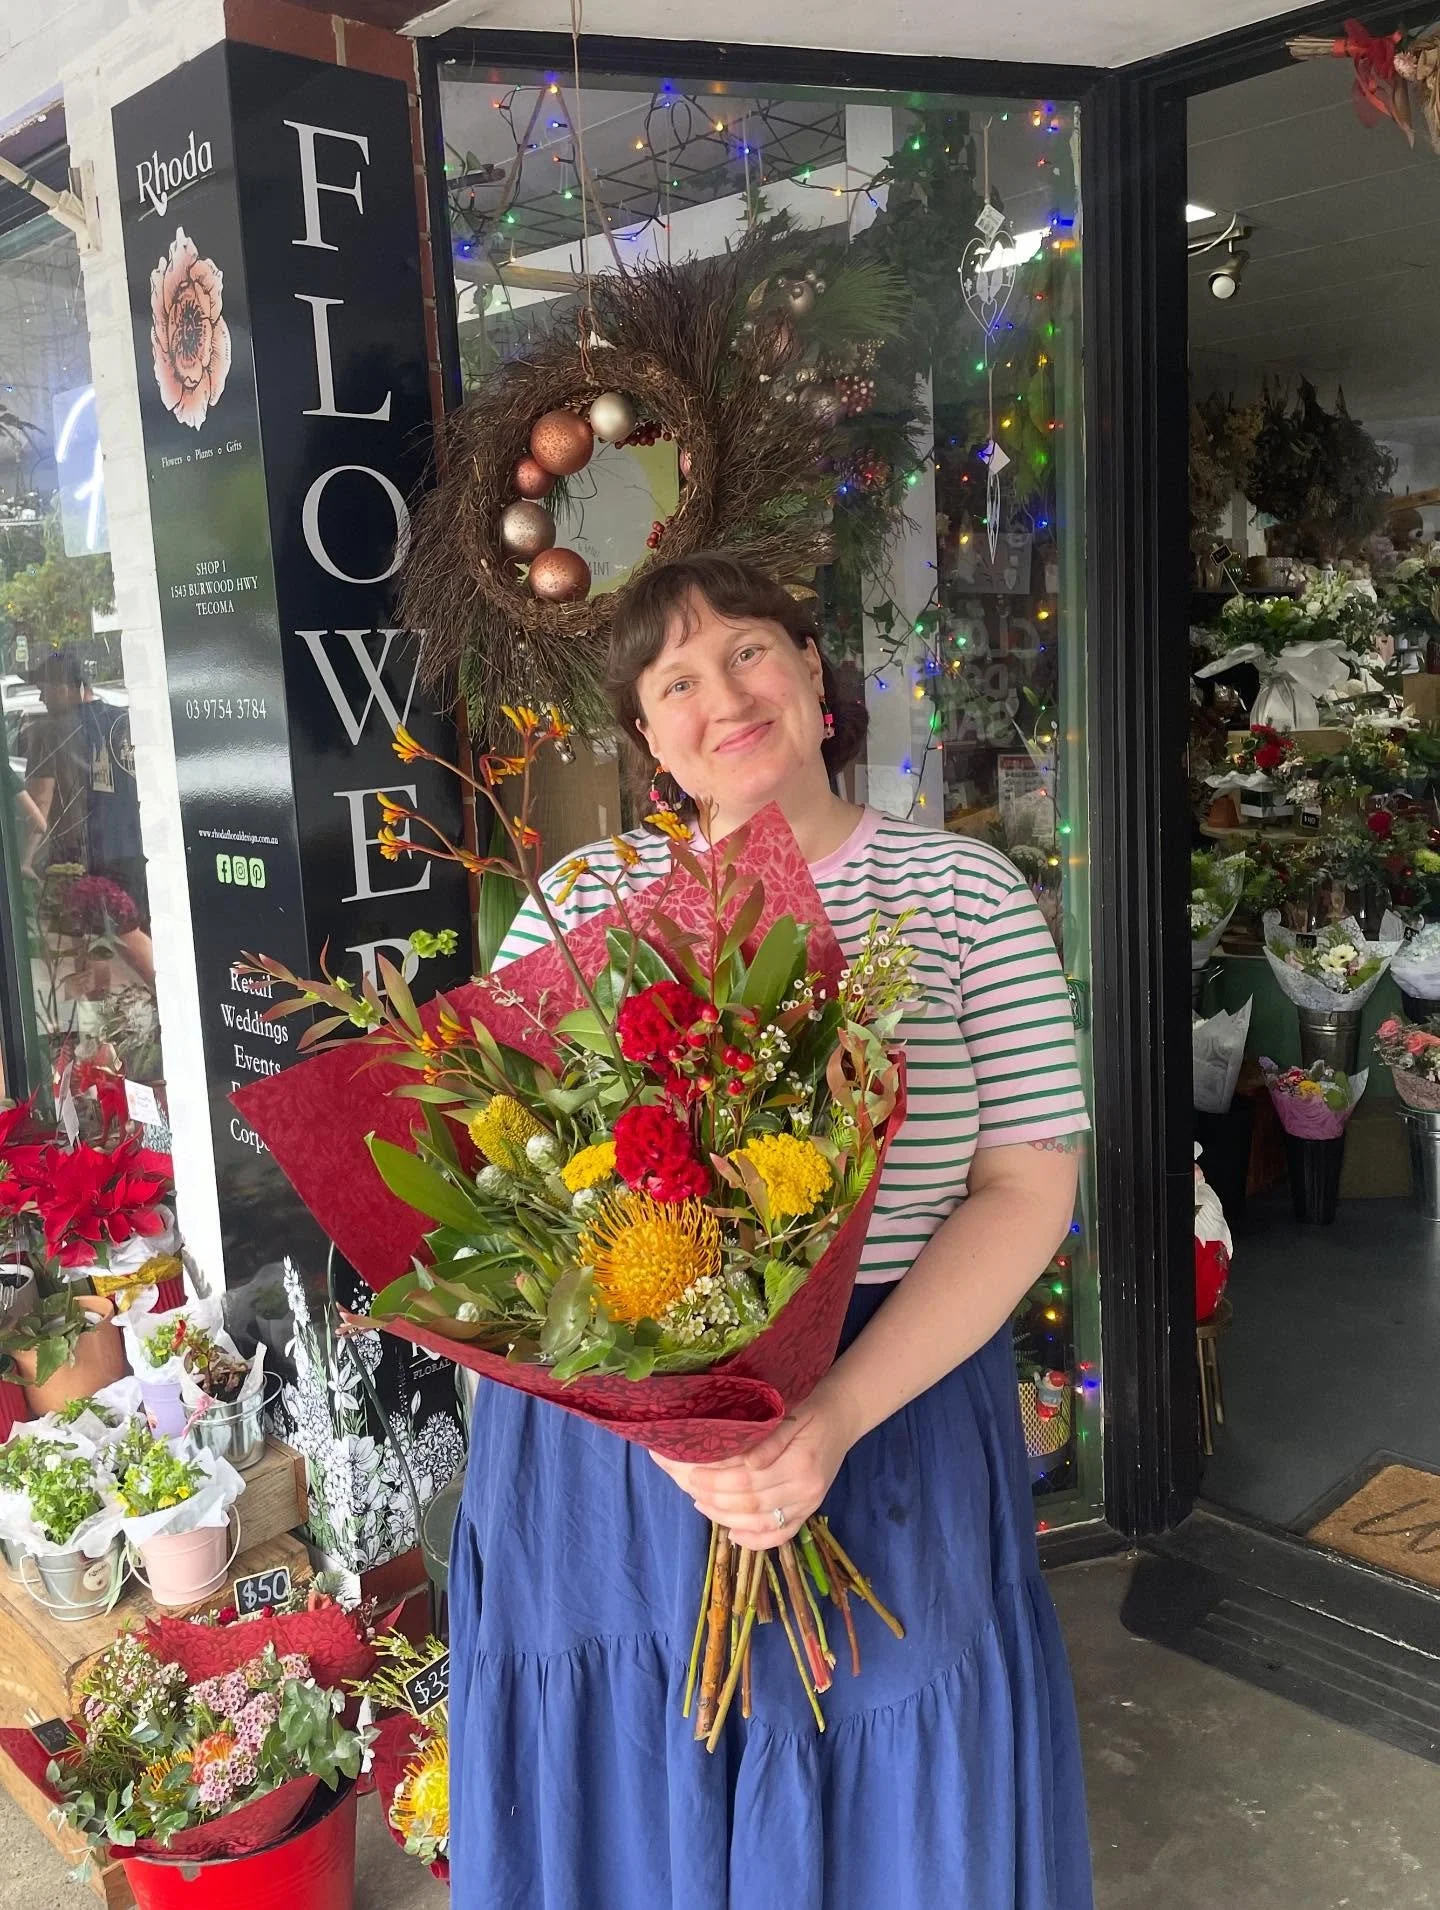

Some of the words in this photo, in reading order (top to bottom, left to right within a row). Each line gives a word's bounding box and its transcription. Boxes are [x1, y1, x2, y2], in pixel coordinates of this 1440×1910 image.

[136, 129, 213, 217] Rhoda
[161, 456, 182, 468] Flowers
[194, 448, 213, 461] Plants
[226, 439, 242, 453] Gifts
[196, 560, 219, 576] SHOP
[222, 559, 226, 573] 1
[170, 584, 187, 599] 1543
[188, 578, 234, 597] BURWOOD
[236, 575, 258, 591] HWY
[195, 599, 235, 616] TECOMA
[186, 699, 200, 719] 03
[203, 699, 232, 719] 9754
[236, 698, 266, 719] 3784
[220, 1003, 289, 1044] Weddings
[233, 1044, 281, 1076] Events
[412, 1358, 451, 1380] FLORAL
[242, 1570, 288, 1609] $50
